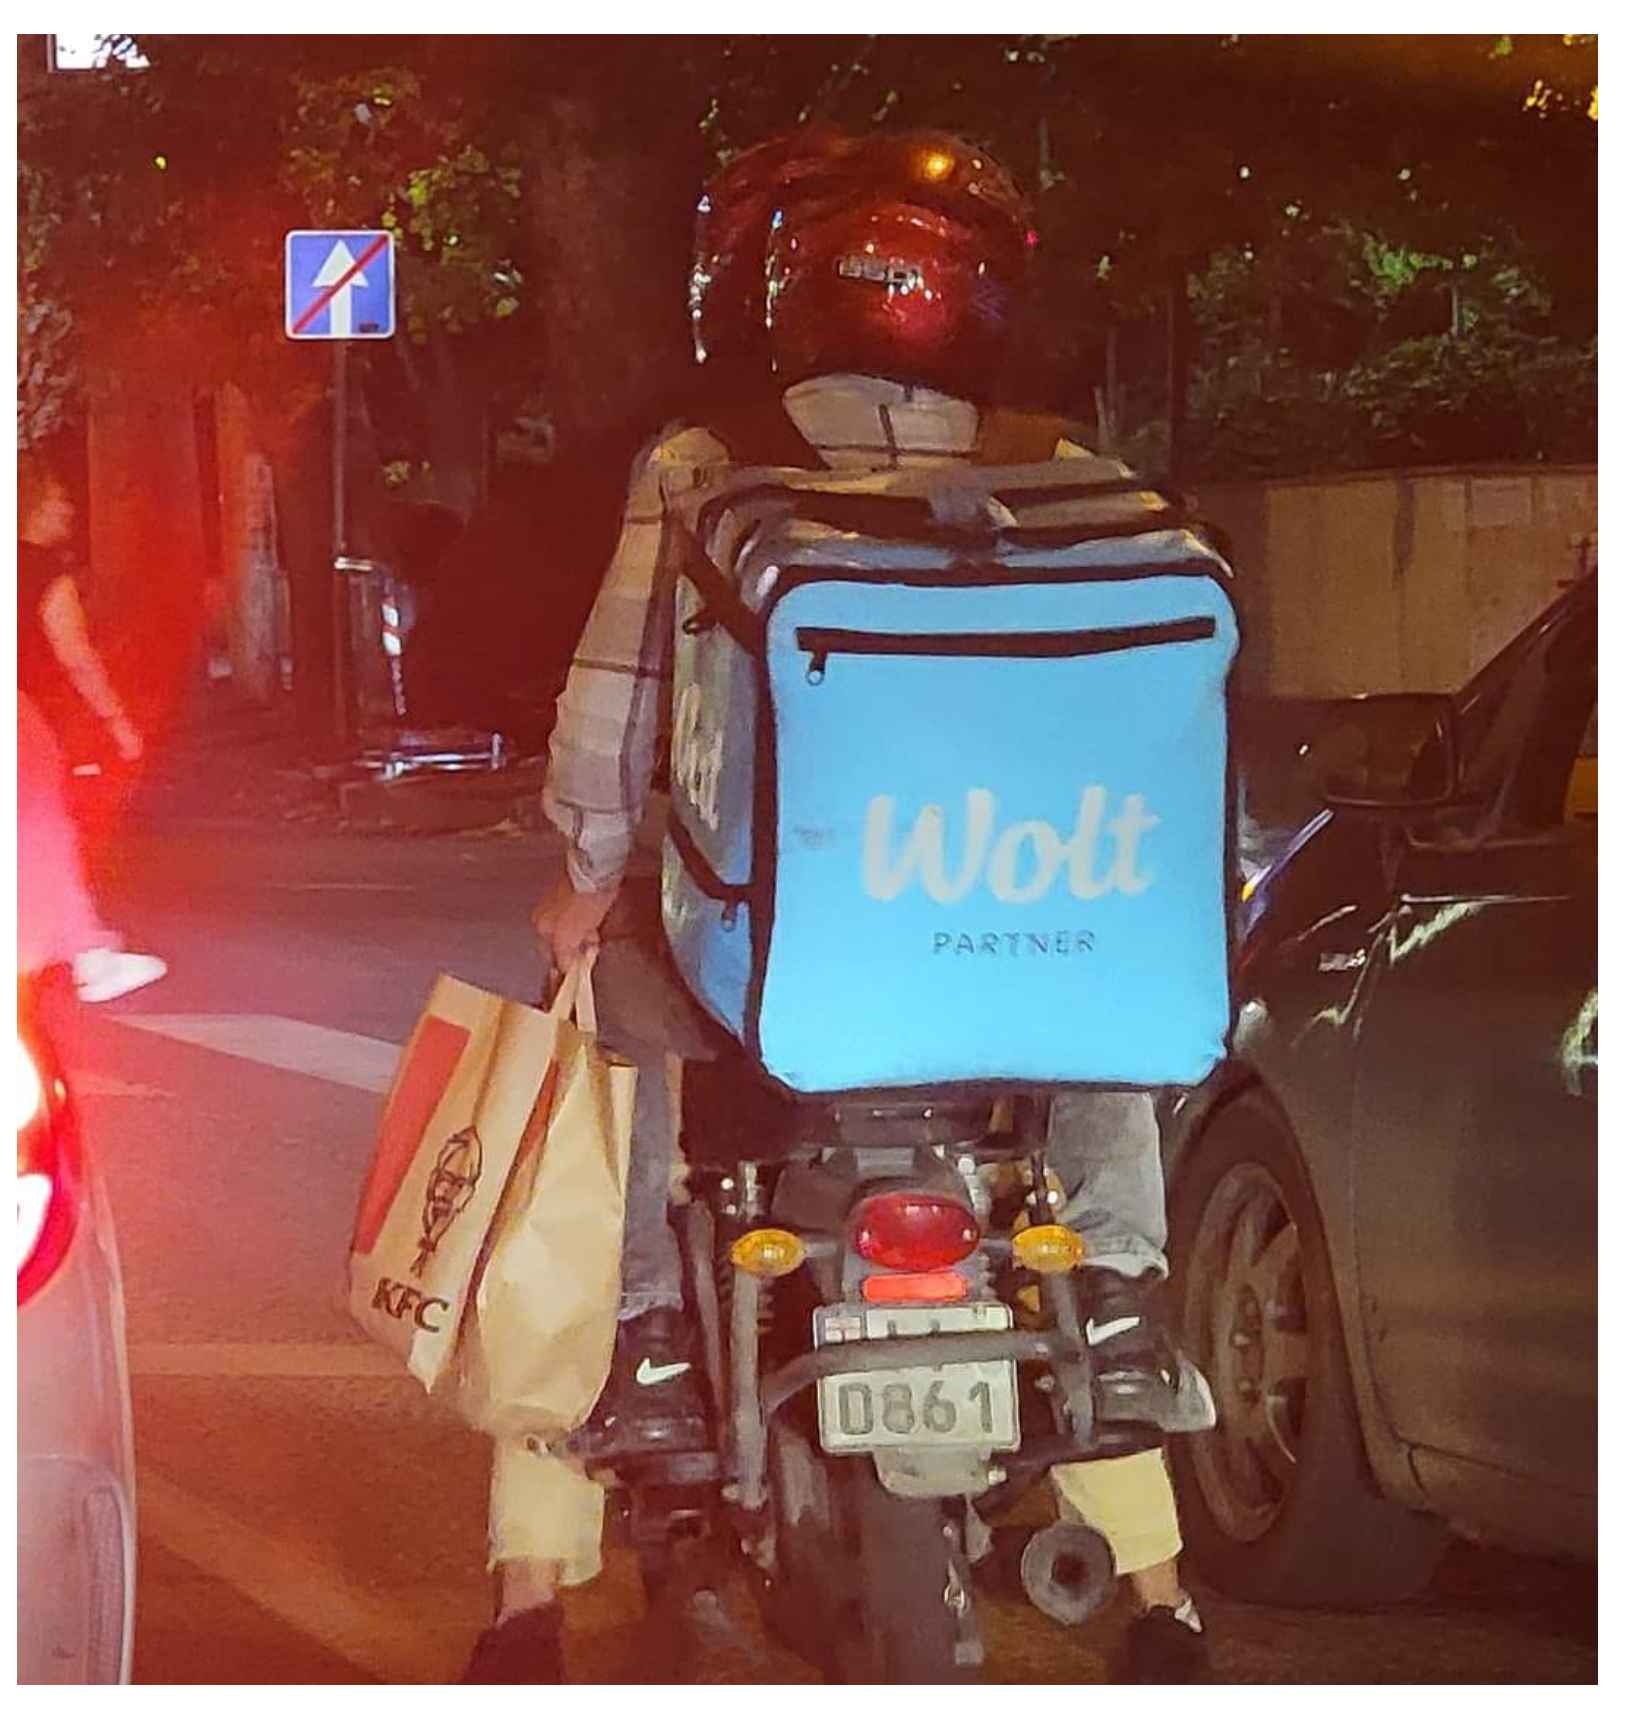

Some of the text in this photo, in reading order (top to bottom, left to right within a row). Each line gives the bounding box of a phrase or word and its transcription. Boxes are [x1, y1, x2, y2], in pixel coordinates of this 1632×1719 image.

[862, 784, 1162, 904] Wolt
[932, 929, 1096, 956] PARTNER
[372, 1277, 448, 1333] KFC
